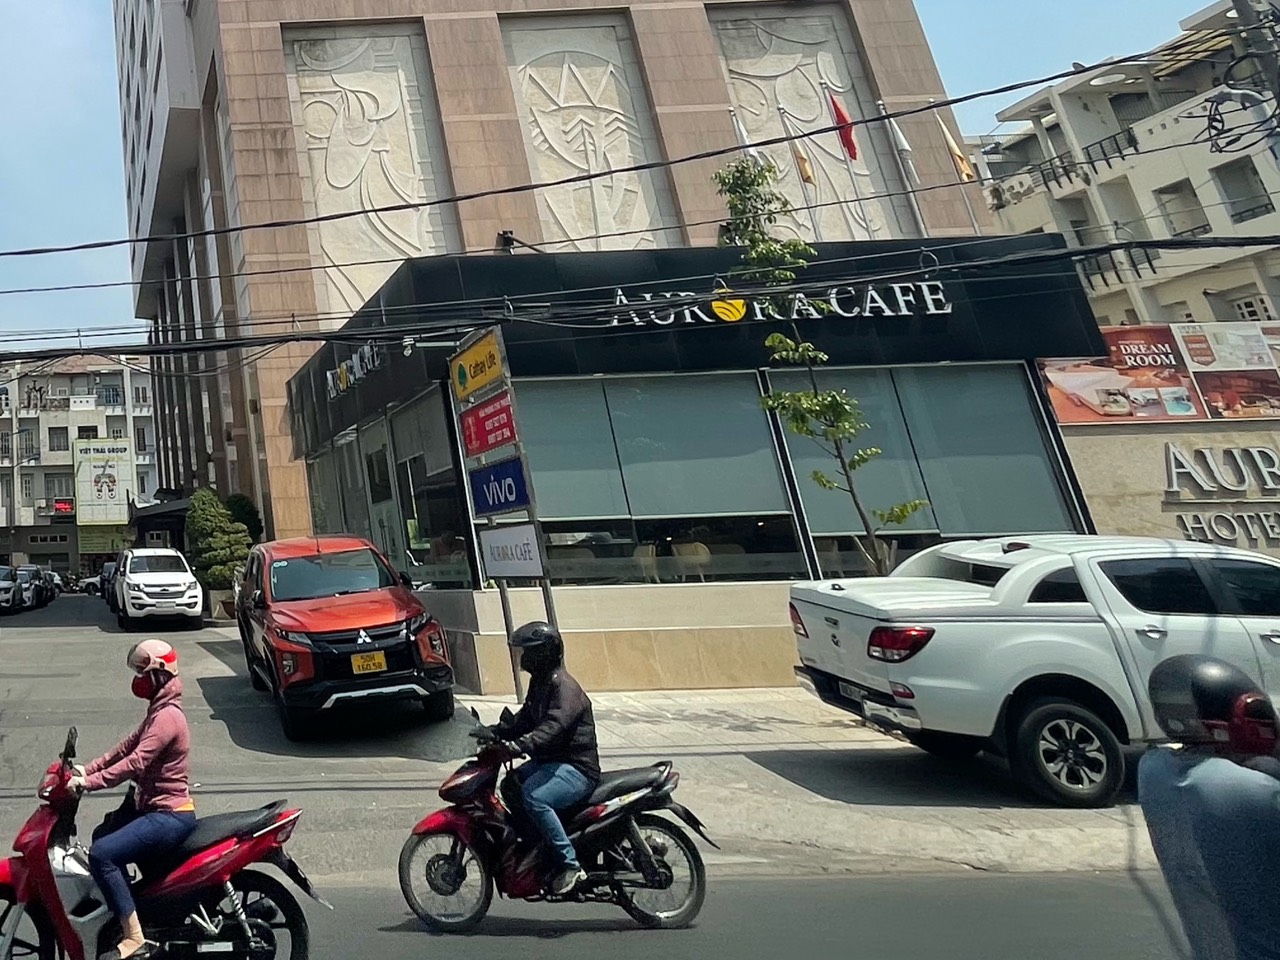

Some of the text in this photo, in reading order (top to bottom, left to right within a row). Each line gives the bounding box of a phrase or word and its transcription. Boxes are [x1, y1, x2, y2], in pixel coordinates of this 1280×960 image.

[830, 280, 953, 319] CAFE
[1120, 343, 1172, 355] DREAM
[1124, 354, 1177, 367] ROOM
